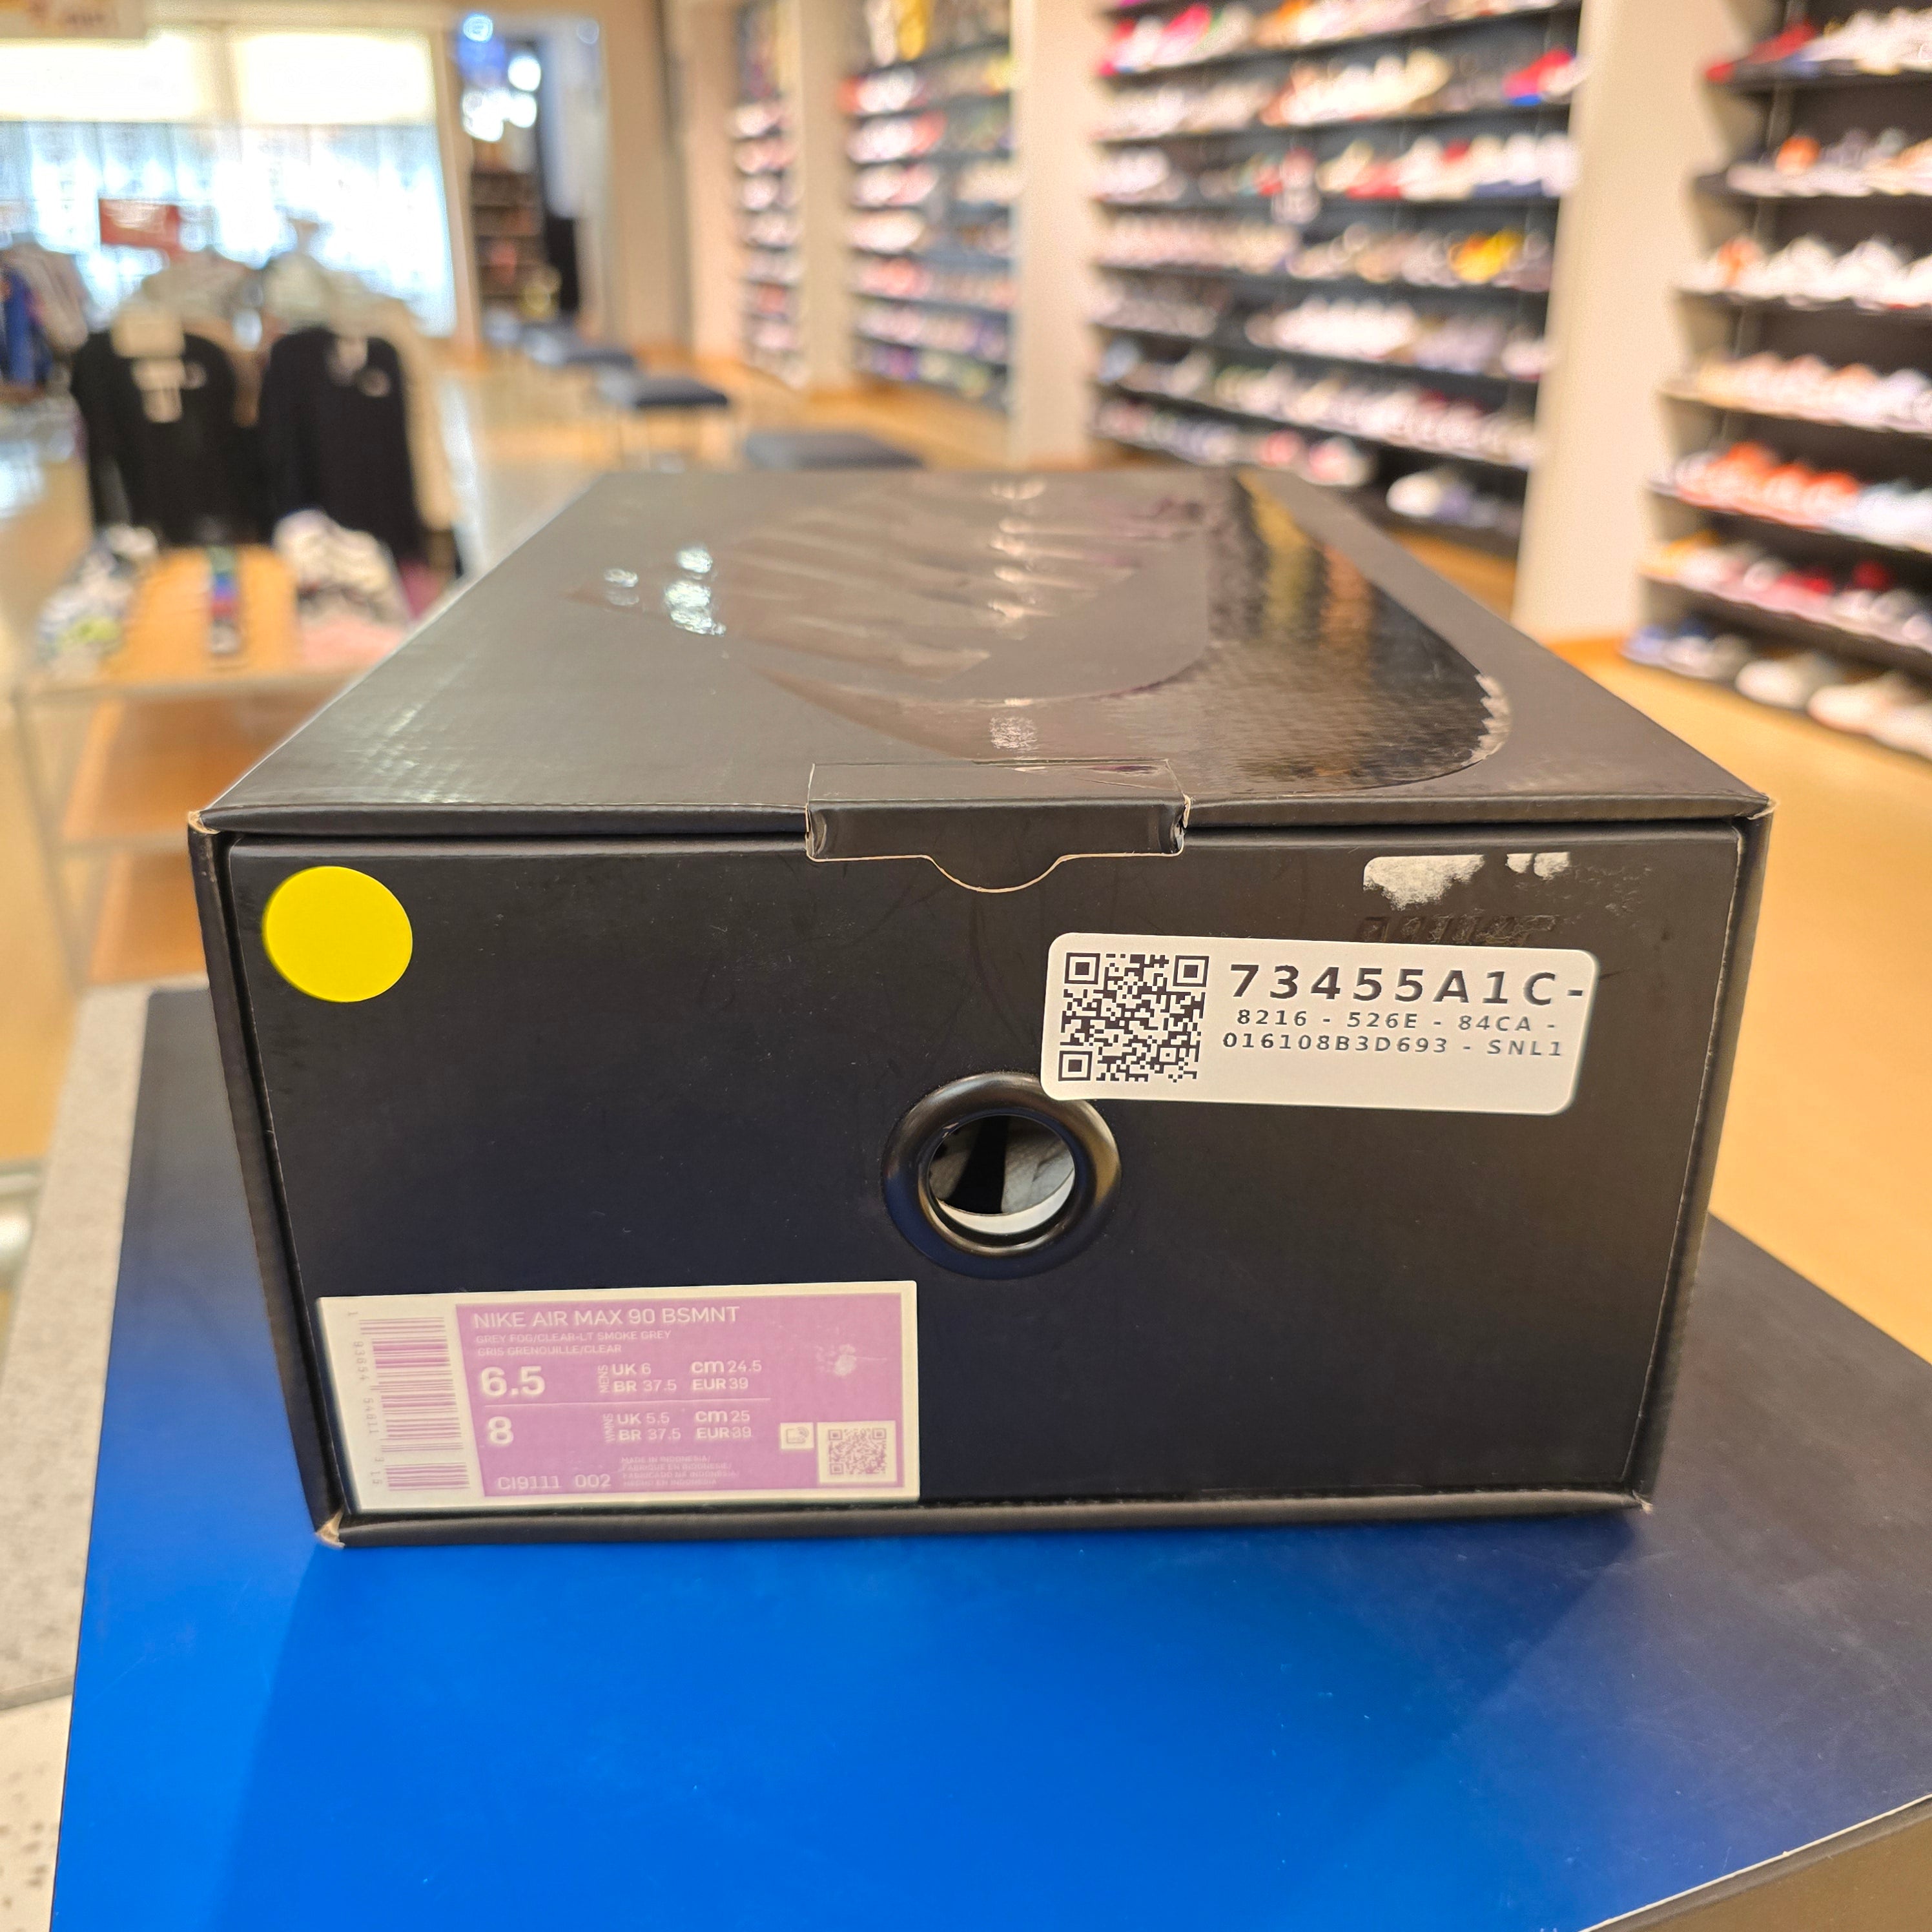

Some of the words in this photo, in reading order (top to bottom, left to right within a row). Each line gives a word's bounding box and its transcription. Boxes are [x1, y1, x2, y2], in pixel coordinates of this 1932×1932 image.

[1230, 963, 1583, 1006] 73455A1C-
[1236, 1009, 1307, 1026] 8216
[1346, 1011, 1417, 1029] 526E
[1457, 1015, 1531, 1032] 84CA
[1222, 1032, 1447, 1053] 016108B3D693
[1486, 1038, 1561, 1056] SNL1
[473, 1311, 526, 1328] NIKE
[532, 1310, 568, 1327] AIR
[574, 1308, 624, 1326] MAX
[628, 1308, 655, 1324] 90
[662, 1306, 740, 1323] BSMNT
[476, 1335, 506, 1344] GREY
[597, 1330, 637, 1341] SMOKE
[641, 1330, 672, 1340] GREY
[477, 1346, 504, 1357] GRIS
[612, 1363, 636, 1375] UK
[641, 1362, 652, 1375] 6
[691, 1361, 724, 1374] cm
[728, 1360, 762, 1373] 24.5
[480, 1365, 546, 1397] 6.5
[598, 1364, 610, 1393] MENS
[692, 1377, 726, 1391] EUR
[728, 1377, 749, 1390] 39
[613, 1380, 637, 1393] BR
[642, 1379, 677, 1392] 37.5
[617, 1413, 641, 1425] UK
[646, 1412, 670, 1424] 5.5
[695, 1410, 728, 1423] cm
[730, 1410, 750, 1423] 25
[487, 1415, 514, 1444] 8
[619, 1429, 641, 1441] BR
[648, 1428, 681, 1441] 37.5
[696, 1427, 730, 1440] EUR
[732, 1426, 752, 1439] 39
[497, 1475, 560, 1490] CI9111
[574, 1474, 612, 1489] 002
